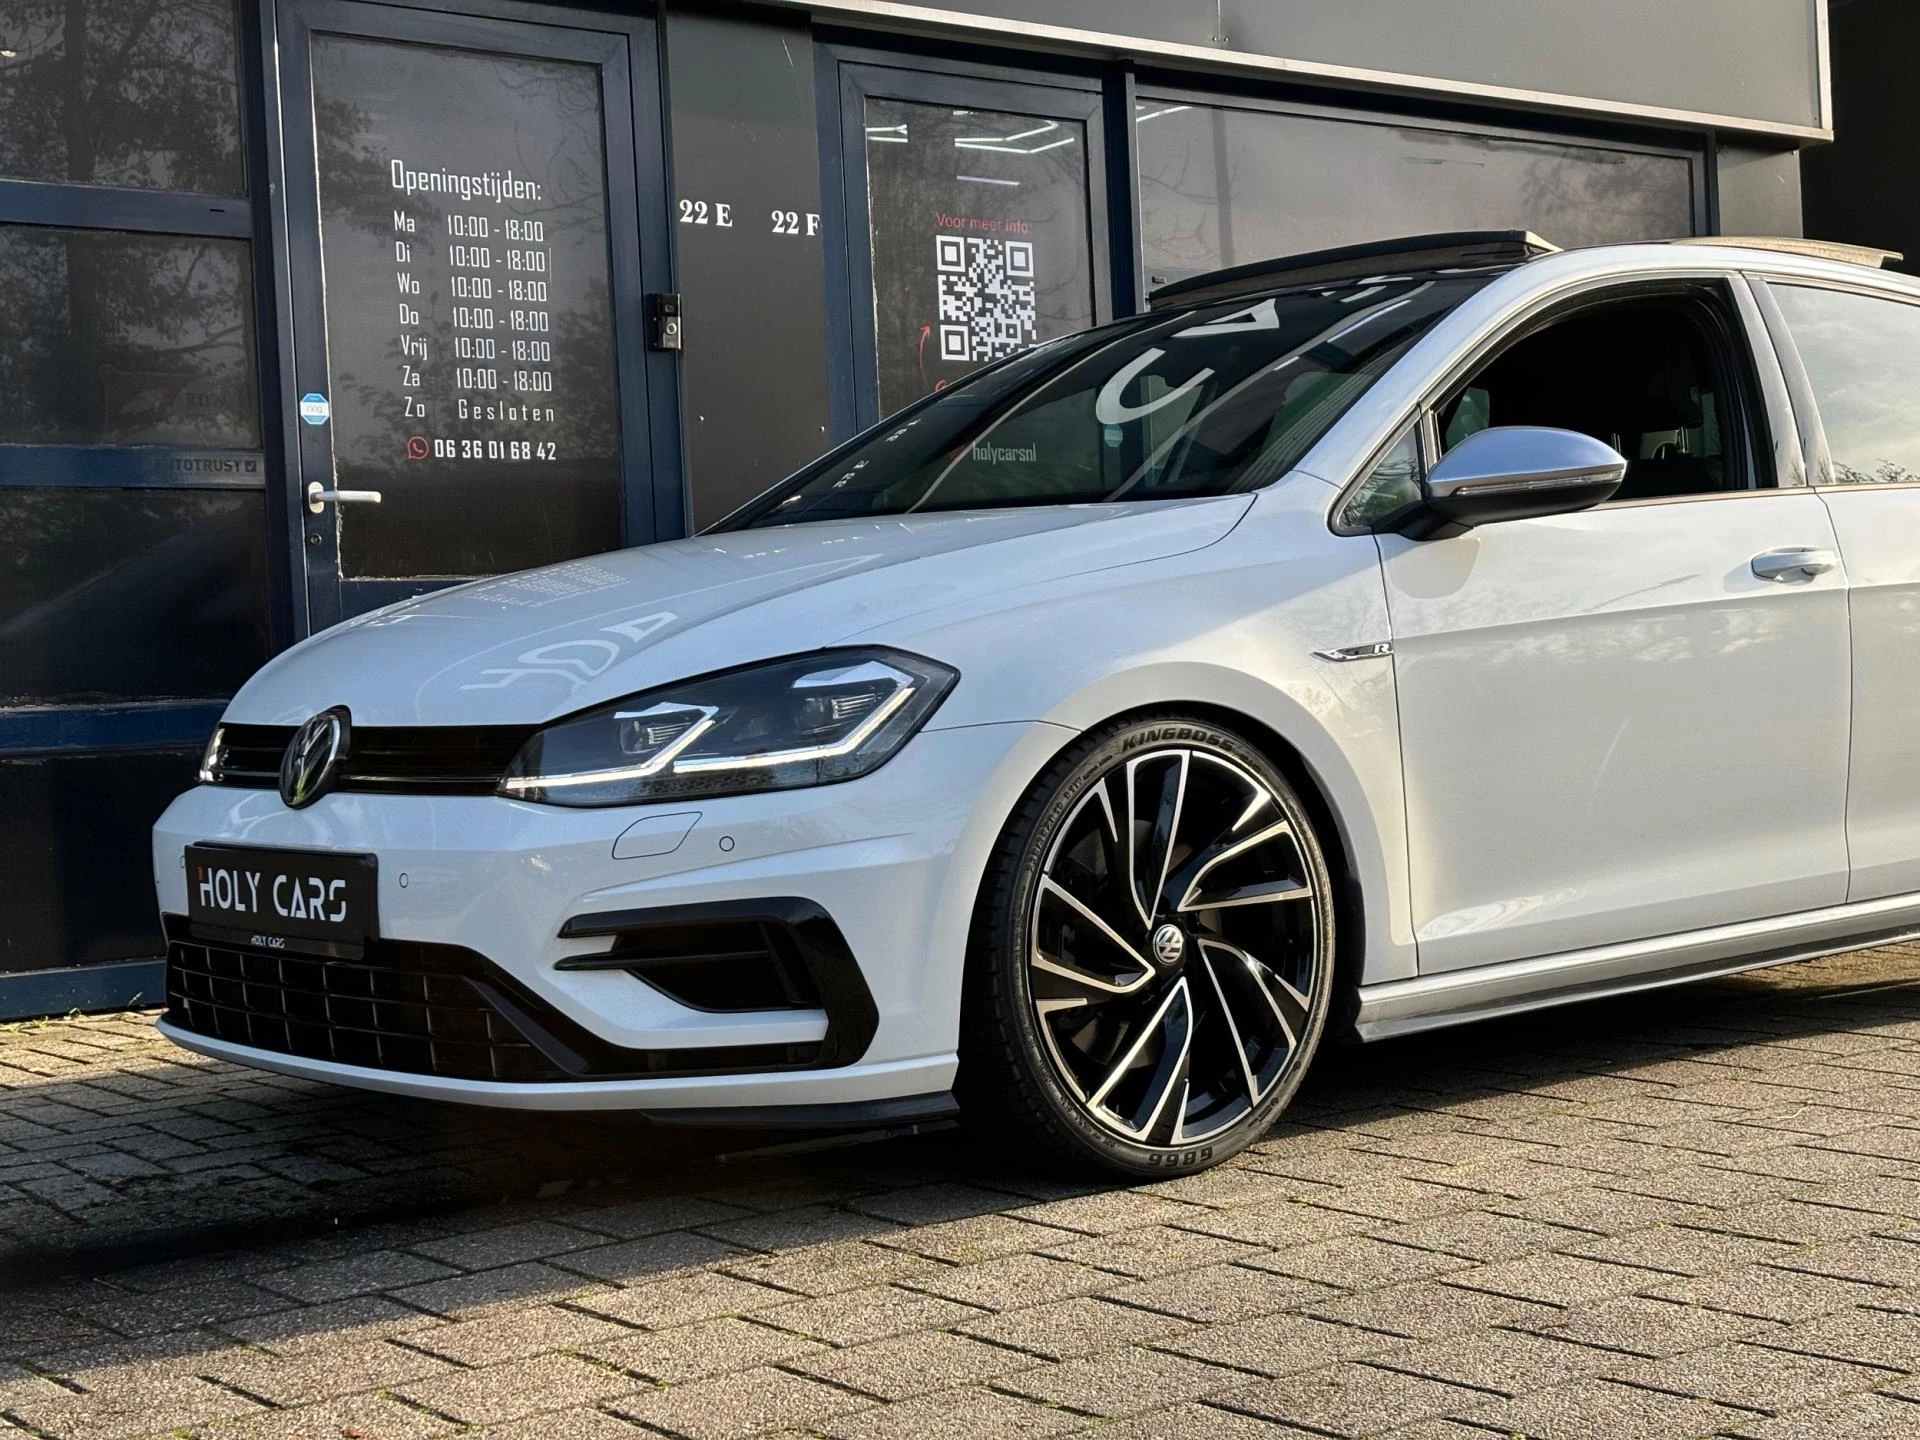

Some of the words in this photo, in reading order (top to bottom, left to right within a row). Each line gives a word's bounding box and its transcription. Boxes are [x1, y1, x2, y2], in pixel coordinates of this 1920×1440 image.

[391, 159, 542, 203] Openingstijden:
[394, 210, 415, 232] Ma
[448, 215, 488, 237] 10:00
[505, 219, 544, 242] 18:00
[680, 199, 709, 225] 22
[715, 202, 733, 227] E
[771, 210, 800, 235] 22
[806, 213, 820, 236] F
[936, 212, 965, 228] Voor
[969, 217, 1003, 231] meer
[1005, 219, 1032, 234] info:
[396, 241, 410, 263] Di
[450, 245, 490, 268] 10:00
[507, 249, 546, 272] 18:00
[397, 272, 420, 294] Wo
[451, 276, 492, 299] 10:00
[509, 280, 547, 302] 18:00
[400, 303, 419, 325] Do
[453, 306, 494, 329] 10:00
[510, 309, 549, 332] 18:00
[401, 334, 428, 360] Vrij
[455, 337, 495, 359] 10:00
[512, 340, 550, 361] 18:00
[402, 365, 420, 386] Za
[456, 368, 497, 389] 10:00
[514, 370, 552, 392] 18:00
[404, 396, 425, 417] Zo
[458, 399, 554, 421] Gesloten
[434, 439, 456, 458] 06
[461, 440, 483, 459] 36
[488, 441, 505, 459] 01
[510, 441, 531, 460] 68
[536, 442, 557, 460] 42
[972, 442, 1037, 465] holycarsnl
[1122, 727, 1235, 752] KINGBOSS
[197, 867, 261, 913] HOLY
[272, 874, 347, 923] CARS
[250, 935, 266, 946] HOLY
[268, 936, 285, 949] CARS
